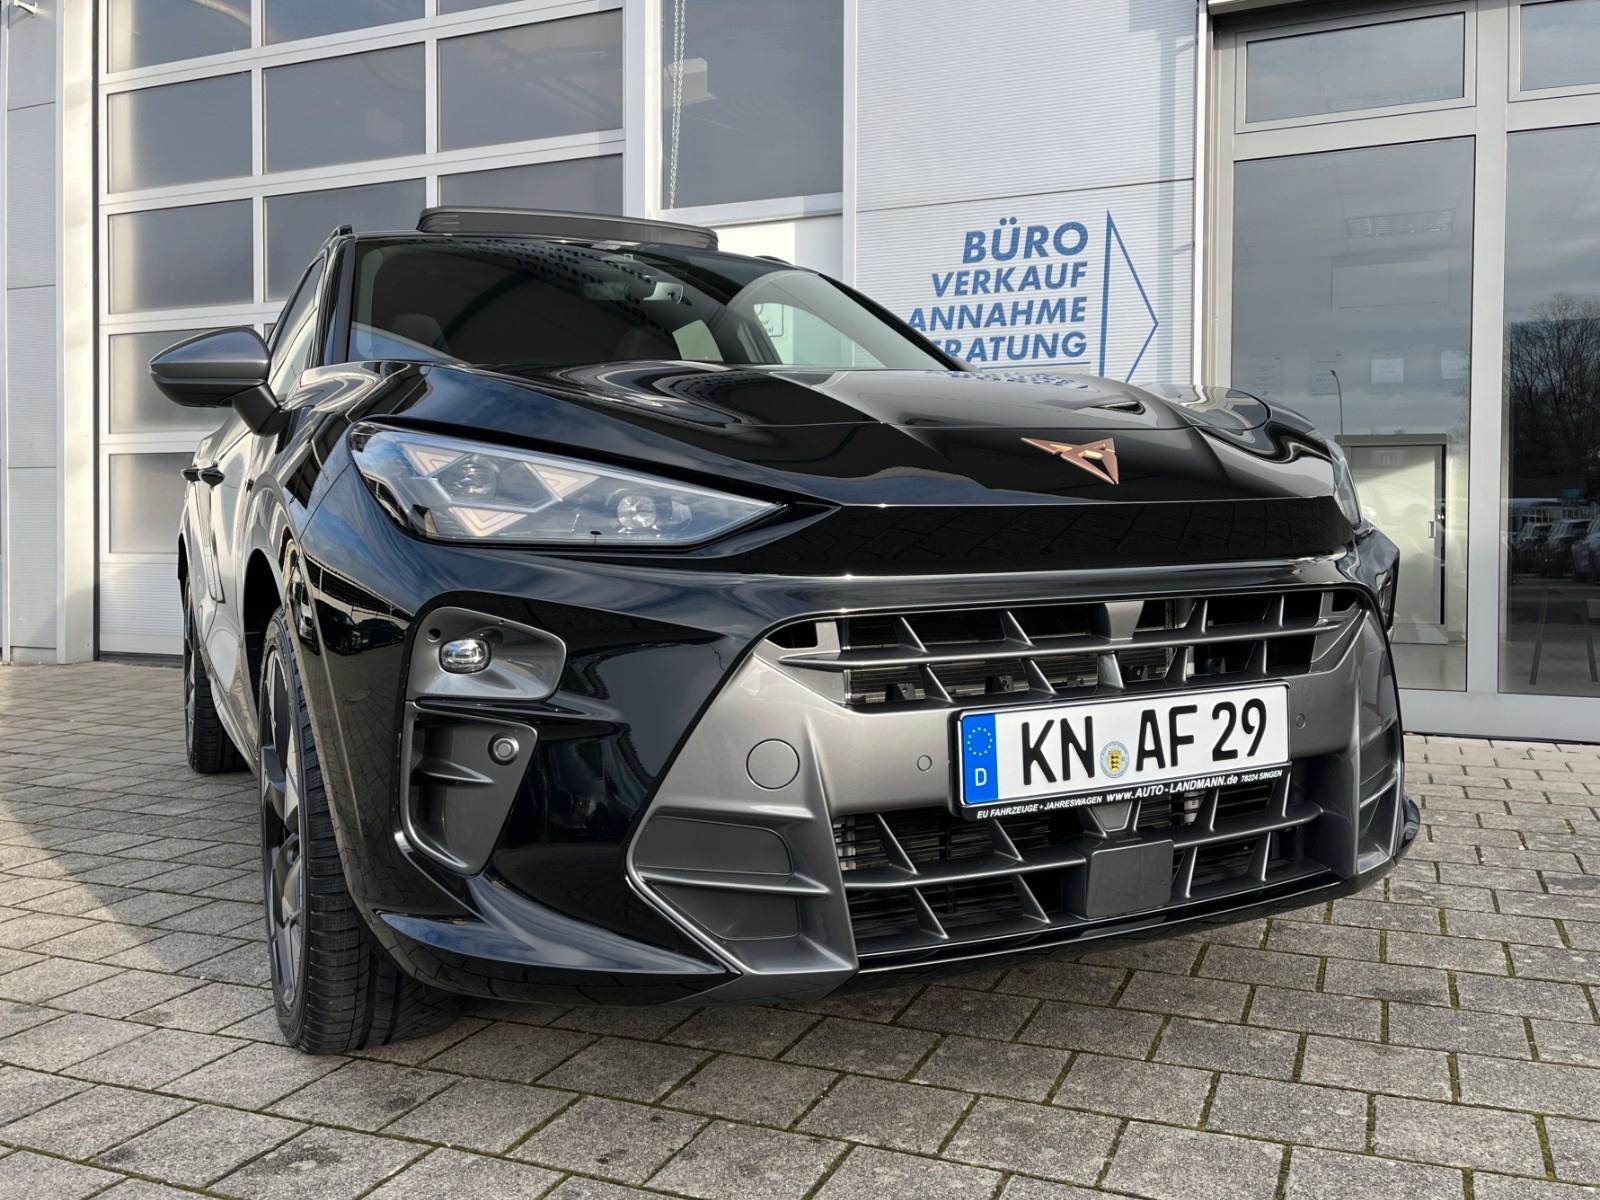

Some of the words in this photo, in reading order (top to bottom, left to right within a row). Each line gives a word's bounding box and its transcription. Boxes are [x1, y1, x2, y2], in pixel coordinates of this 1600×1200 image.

[962, 216, 1089, 264] BÜRO
[931, 261, 1088, 298] VERKAUF
[908, 296, 1088, 332] ANNAHME
[933, 331, 1088, 363] RATUNG
[1021, 716, 1095, 785] KN
[1135, 704, 1198, 772] AF
[1211, 698, 1267, 762] 29
[975, 768, 987, 786] D
[977, 811, 988, 819] EU
[990, 804, 1038, 817] FAHRZEUGE
[1044, 796, 1102, 810] JAHRESWAGEN
[1259, 770, 1282, 780] SINGEN
